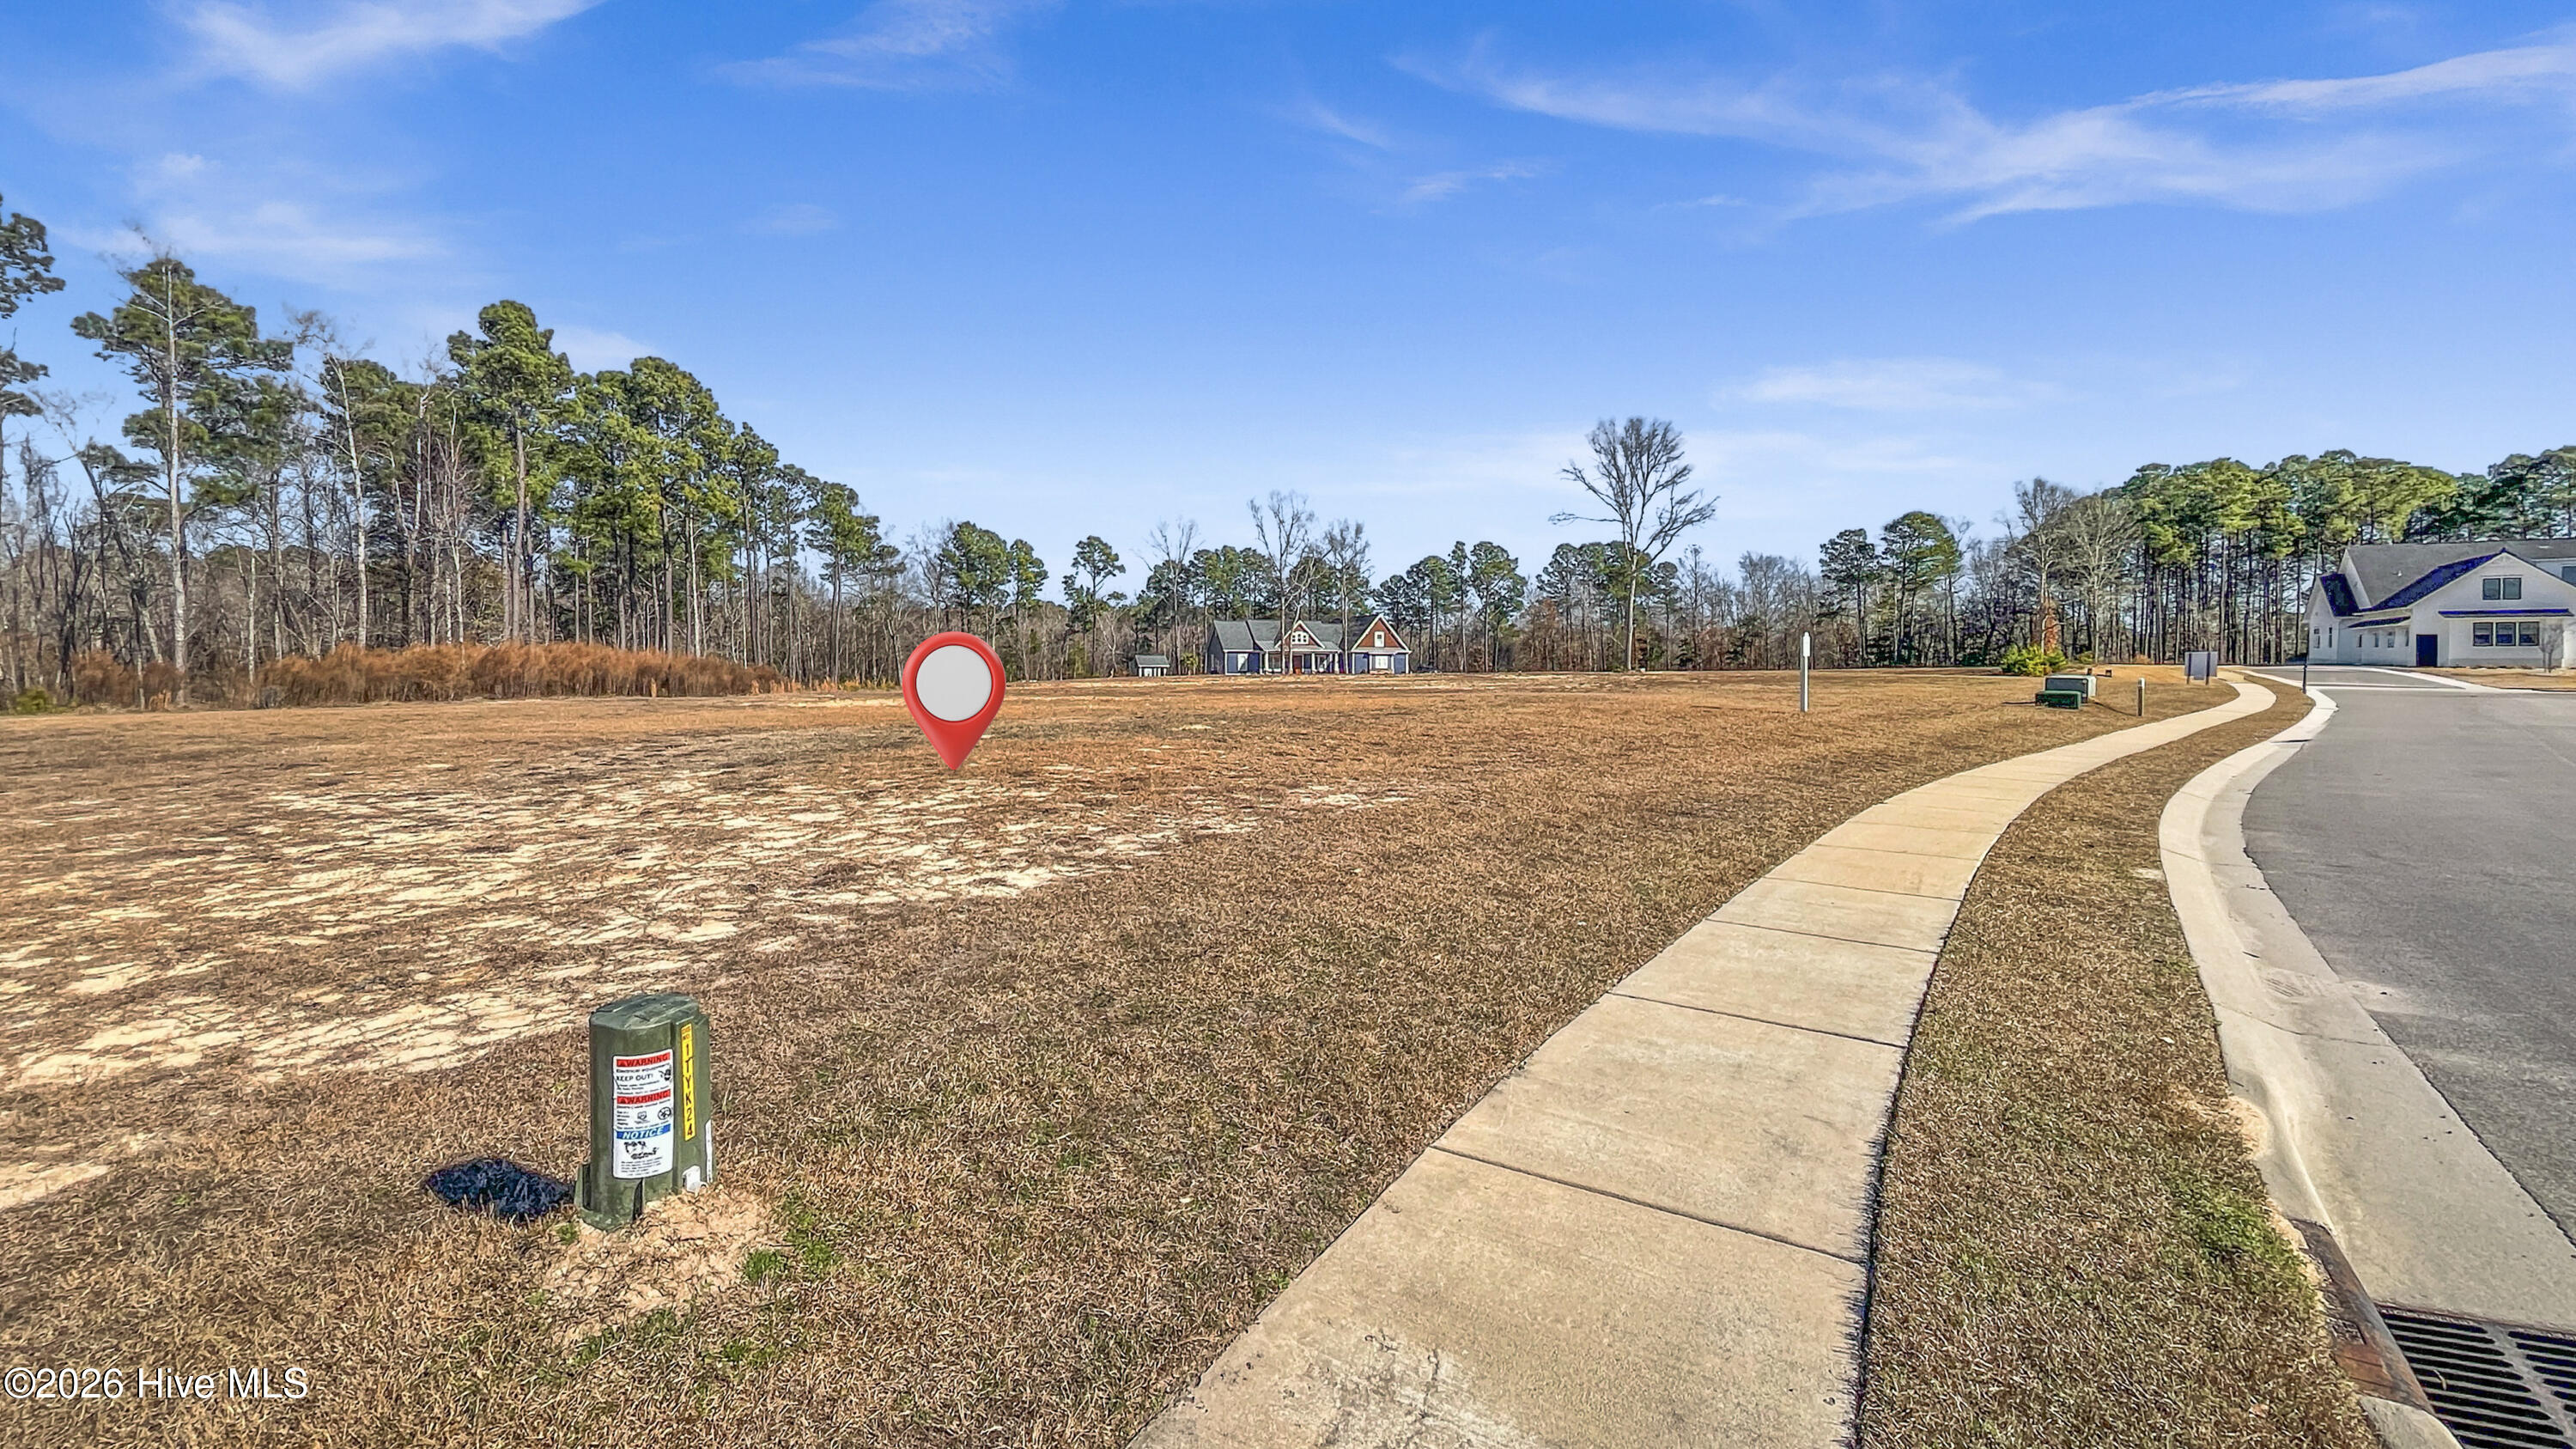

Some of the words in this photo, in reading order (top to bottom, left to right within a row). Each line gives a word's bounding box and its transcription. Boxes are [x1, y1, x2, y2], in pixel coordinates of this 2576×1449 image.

[626, 1052, 668, 1067] WARNING
[626, 1090, 669, 1105] WARNING
[623, 1129, 663, 1140] NOTICE
